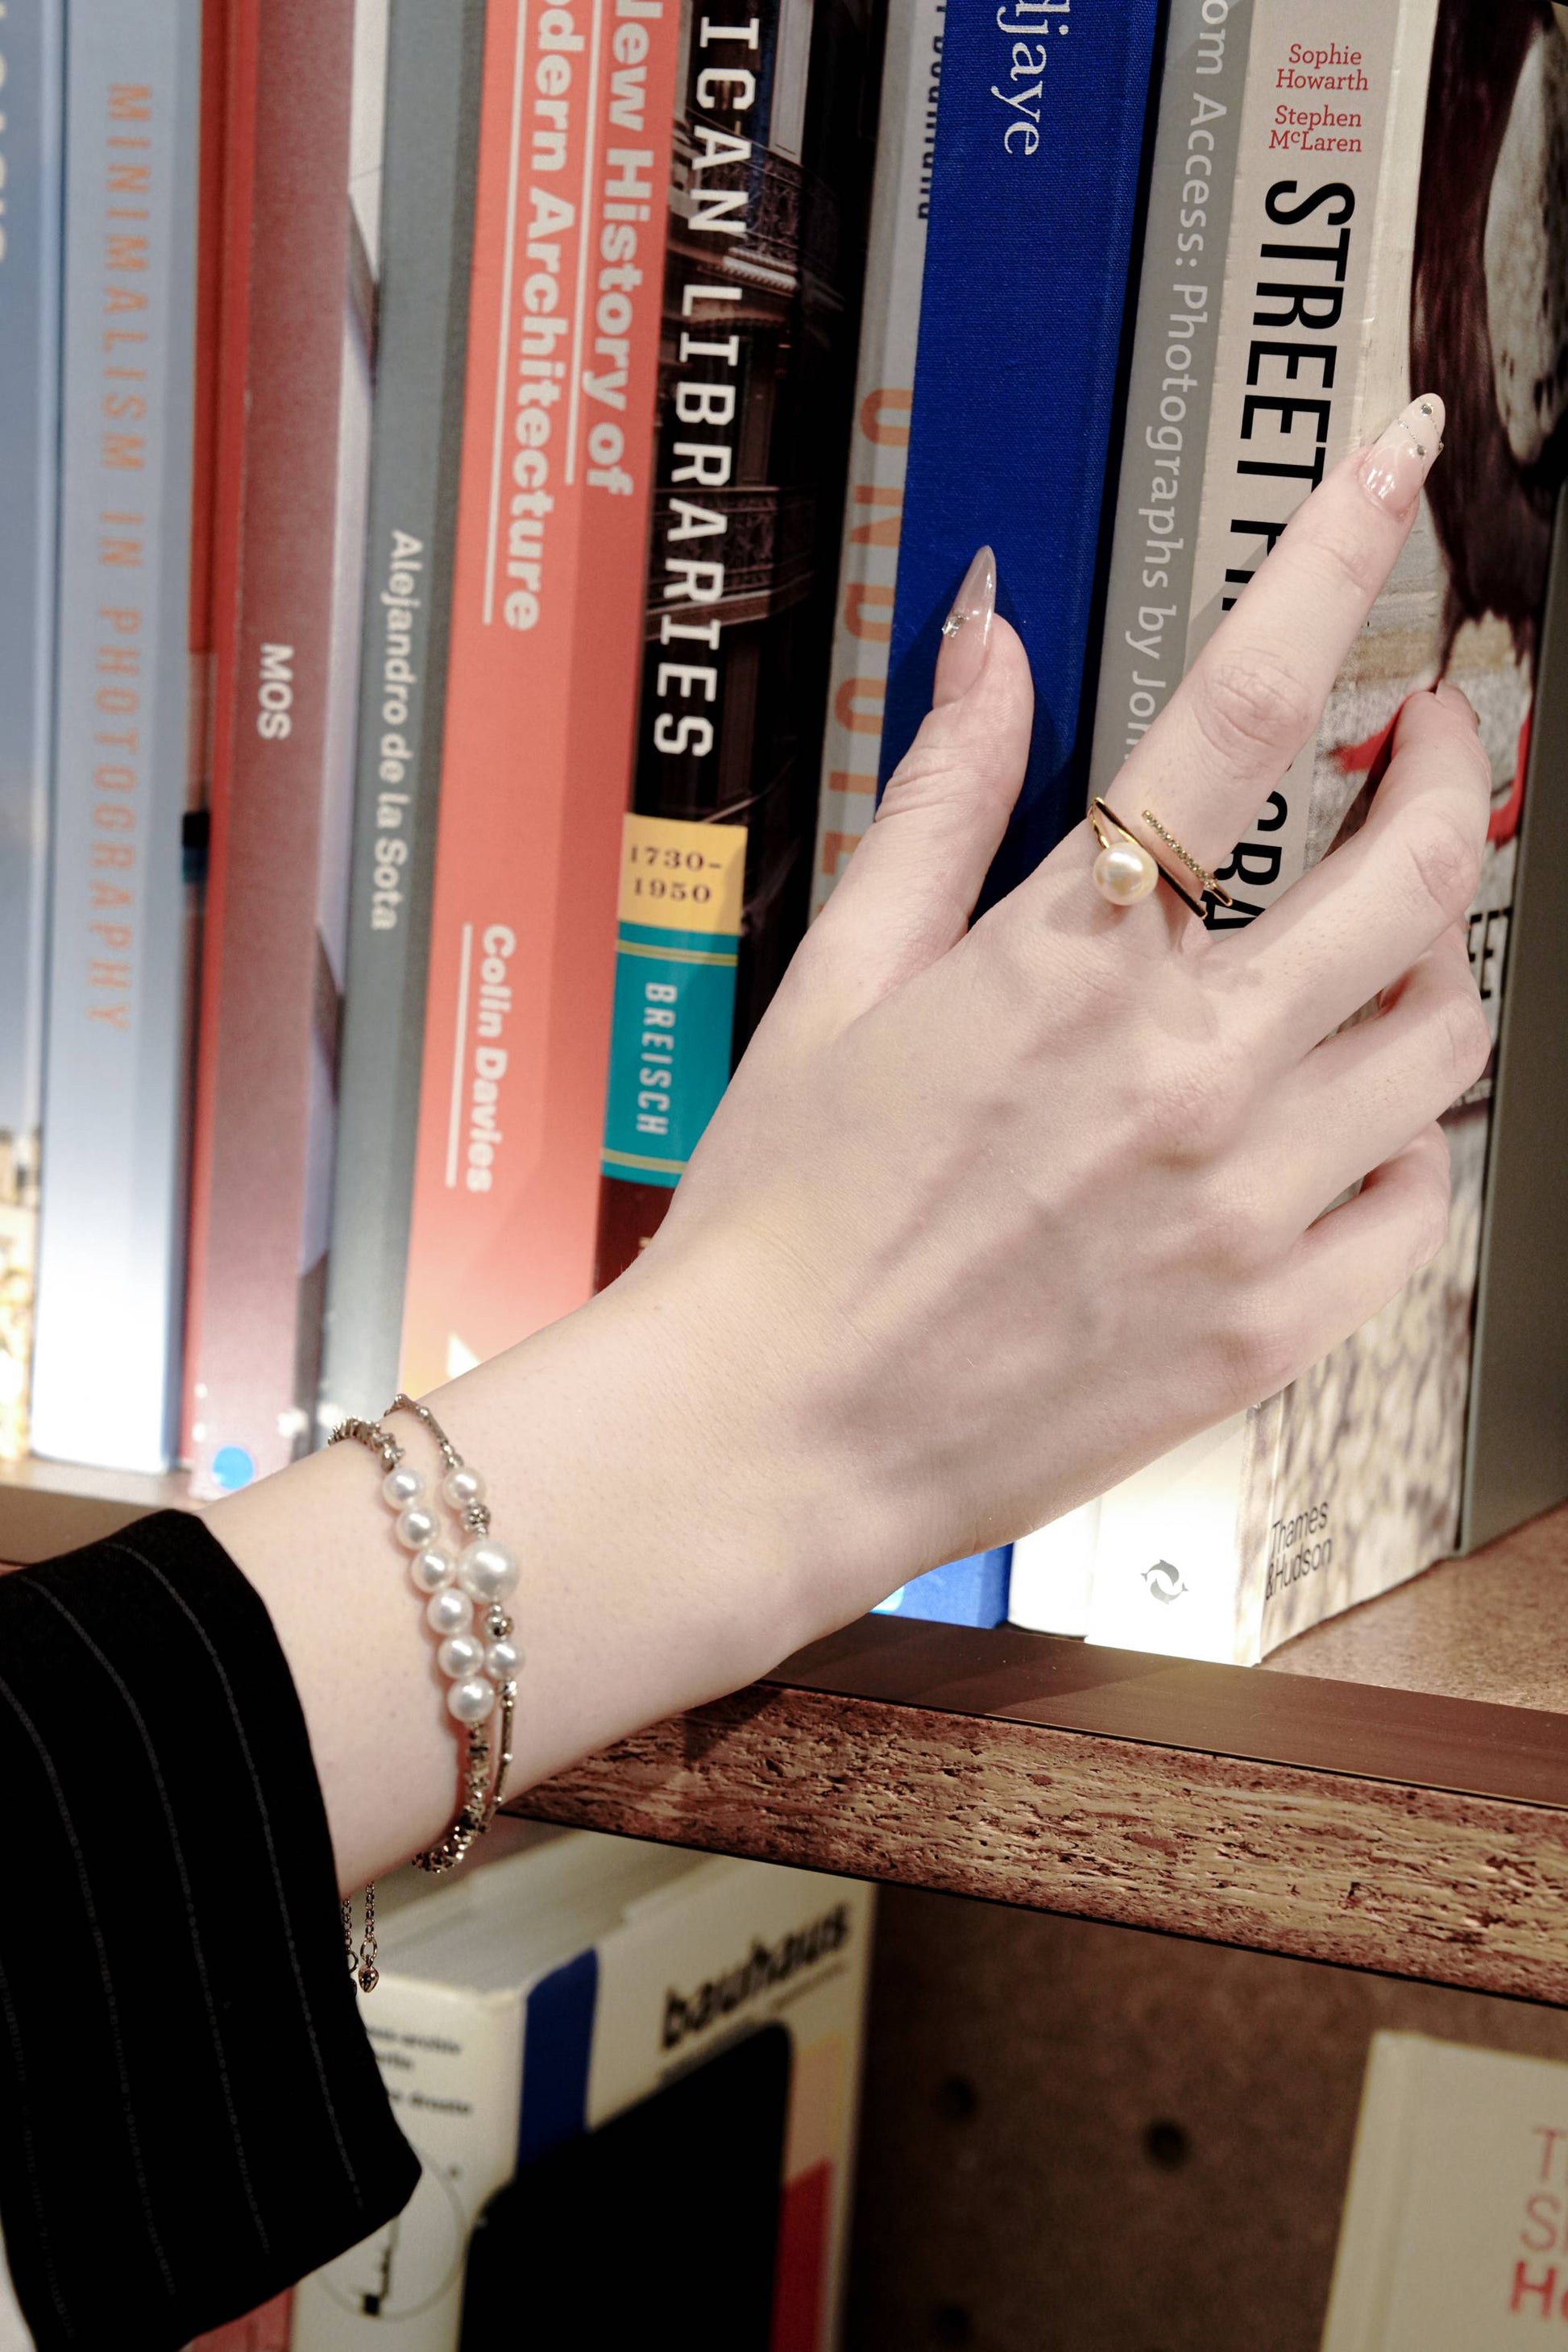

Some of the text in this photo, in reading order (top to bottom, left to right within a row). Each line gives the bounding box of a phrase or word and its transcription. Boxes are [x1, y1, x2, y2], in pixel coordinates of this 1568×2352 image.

[1275, 104, 1362, 131] Stephen
[1276, 68, 1370, 91] Howarth
[1288, 42, 1363, 69] Sophie
[1175, 92, 1227, 267] Access:
[1268, 129, 1363, 152] McLaren
[583, 148, 653, 411] History
[1236, 180, 1356, 493] STREET
[504, 187, 575, 631] Architecture
[587, 422, 633, 496] of
[1138, 282, 1209, 588] Photographs
[87, 84, 152, 1030] MINIMALISM IN PHOTOGRAPHY
[653, 284, 742, 757] LIBRARIES
[256, 642, 294, 740] MOS
[1124, 604, 1177, 660] by
[371, 529, 424, 931] Alejandro de la Sota
[633, 877, 712, 905] 1950
[465, 924, 516, 1193] Colin Davies
[636, 981, 678, 1135] BREISCH
[1271, 1500, 1329, 1560] Thames
